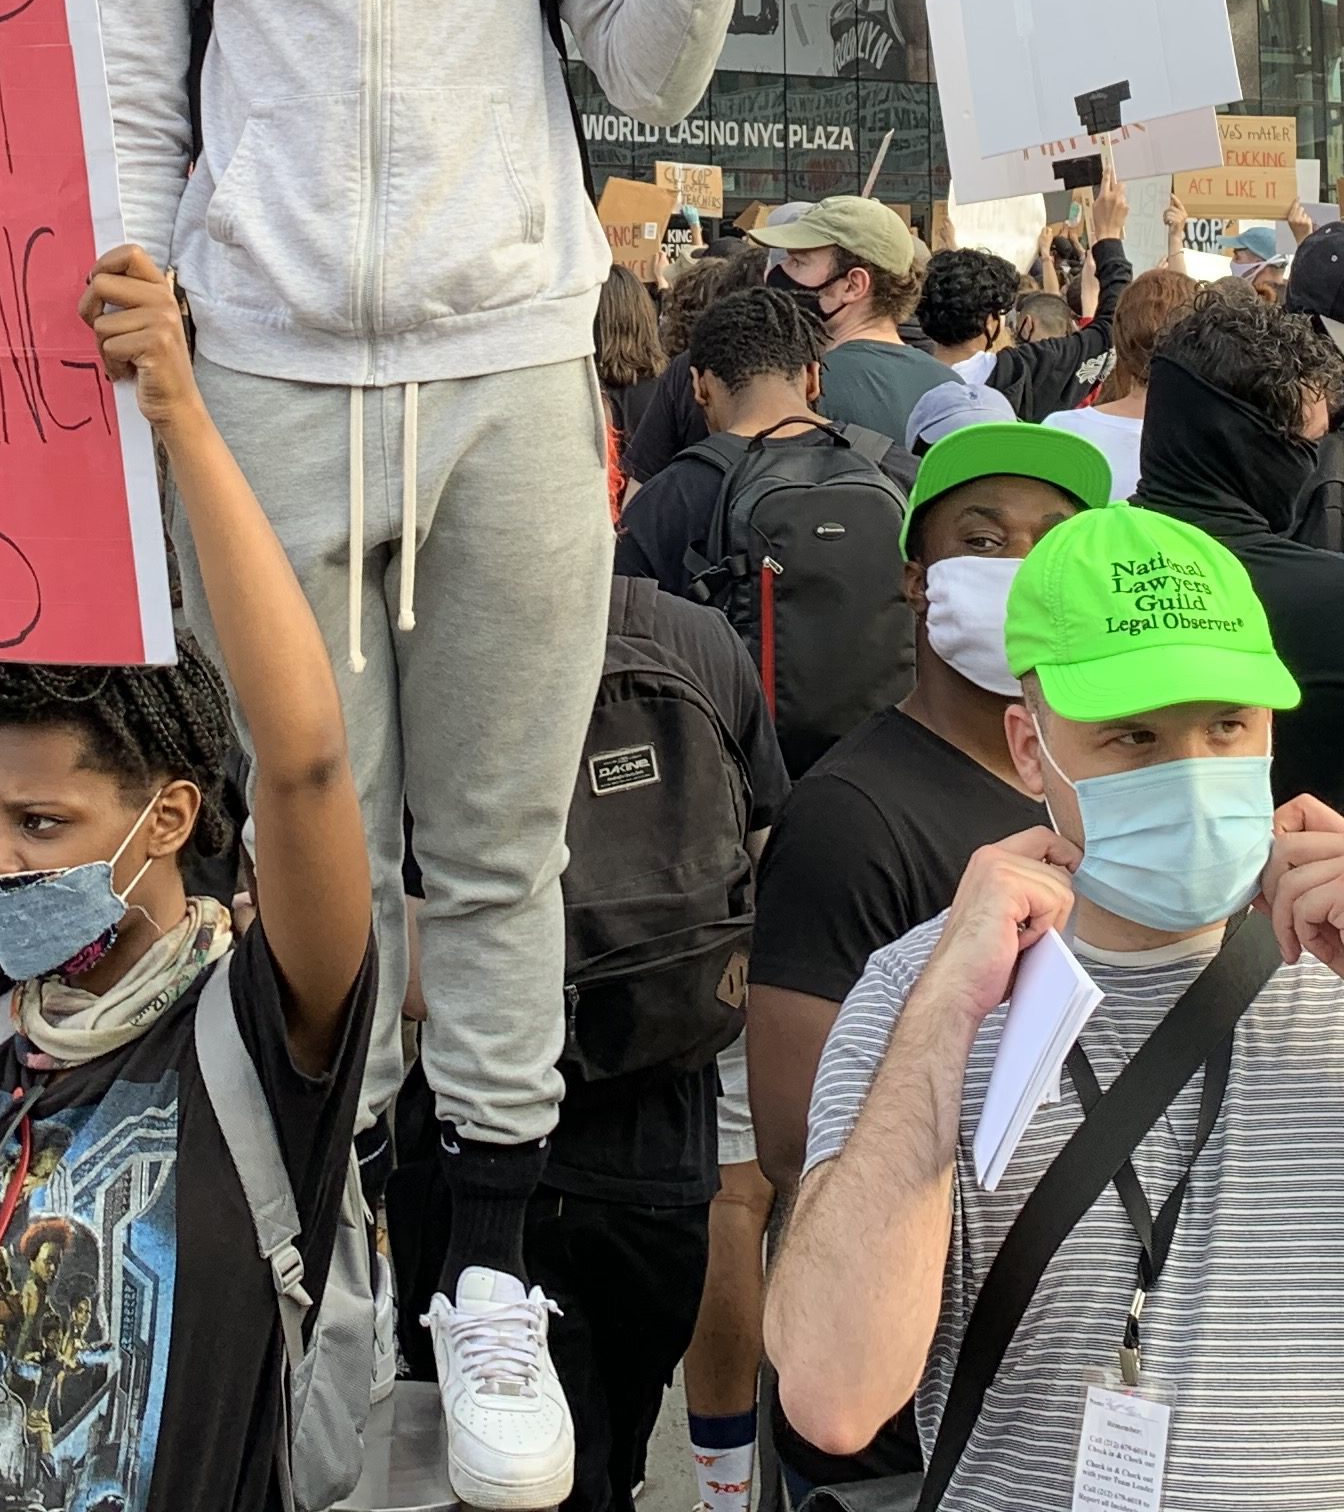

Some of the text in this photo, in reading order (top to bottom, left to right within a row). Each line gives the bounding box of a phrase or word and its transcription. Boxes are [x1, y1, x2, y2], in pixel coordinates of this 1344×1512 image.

[582, 114, 658, 143] WORLD
[744, 122, 785, 149] NYC
[788, 124, 855, 151] PLAZA
[1226, 150, 1287, 168] FUCKING
[1188, 178, 1276, 199] ACT LIKE IT
[681, 193, 722, 208] TEACHERS
[1183, 218, 1222, 242] TOP
[1112, 551, 1207, 578] National
[1112, 574, 1213, 596] Lawyers
[1134, 594, 1208, 612] Guild
[1106, 613, 1160, 636] Legal
[599, 758, 651, 778] DAKINE
